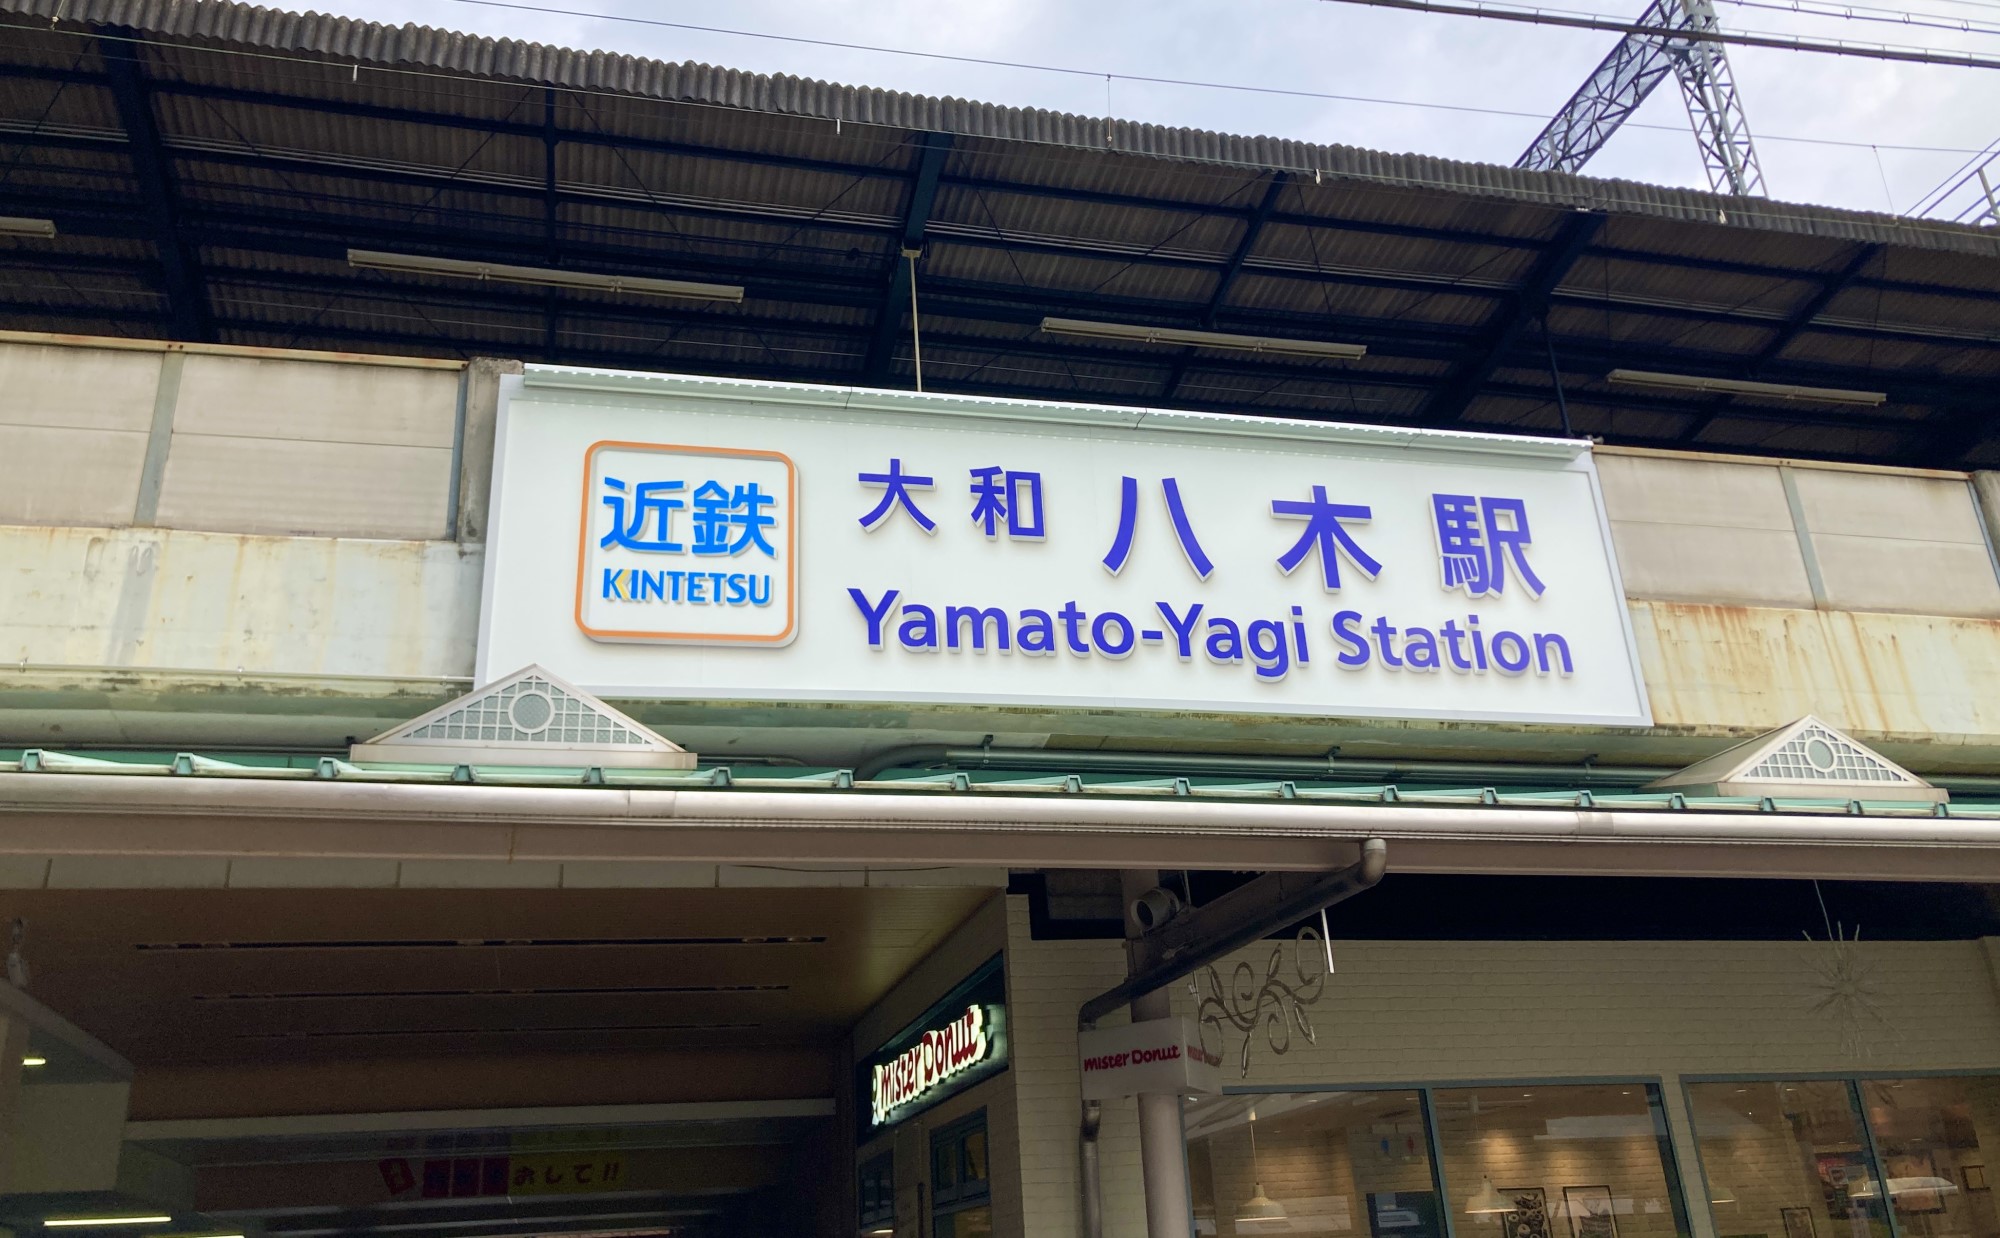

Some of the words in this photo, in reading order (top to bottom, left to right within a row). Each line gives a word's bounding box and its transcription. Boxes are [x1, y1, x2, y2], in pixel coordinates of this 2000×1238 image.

[600, 476, 776, 558] 近鉄
[858, 458, 1547, 598] 大和八木駅
[602, 567, 771, 605] KINTETSU
[848, 588, 1310, 681] Yamato-Yagi
[1332, 609, 1573, 675] Station
[1131, 1044, 1181, 1065] Donut
